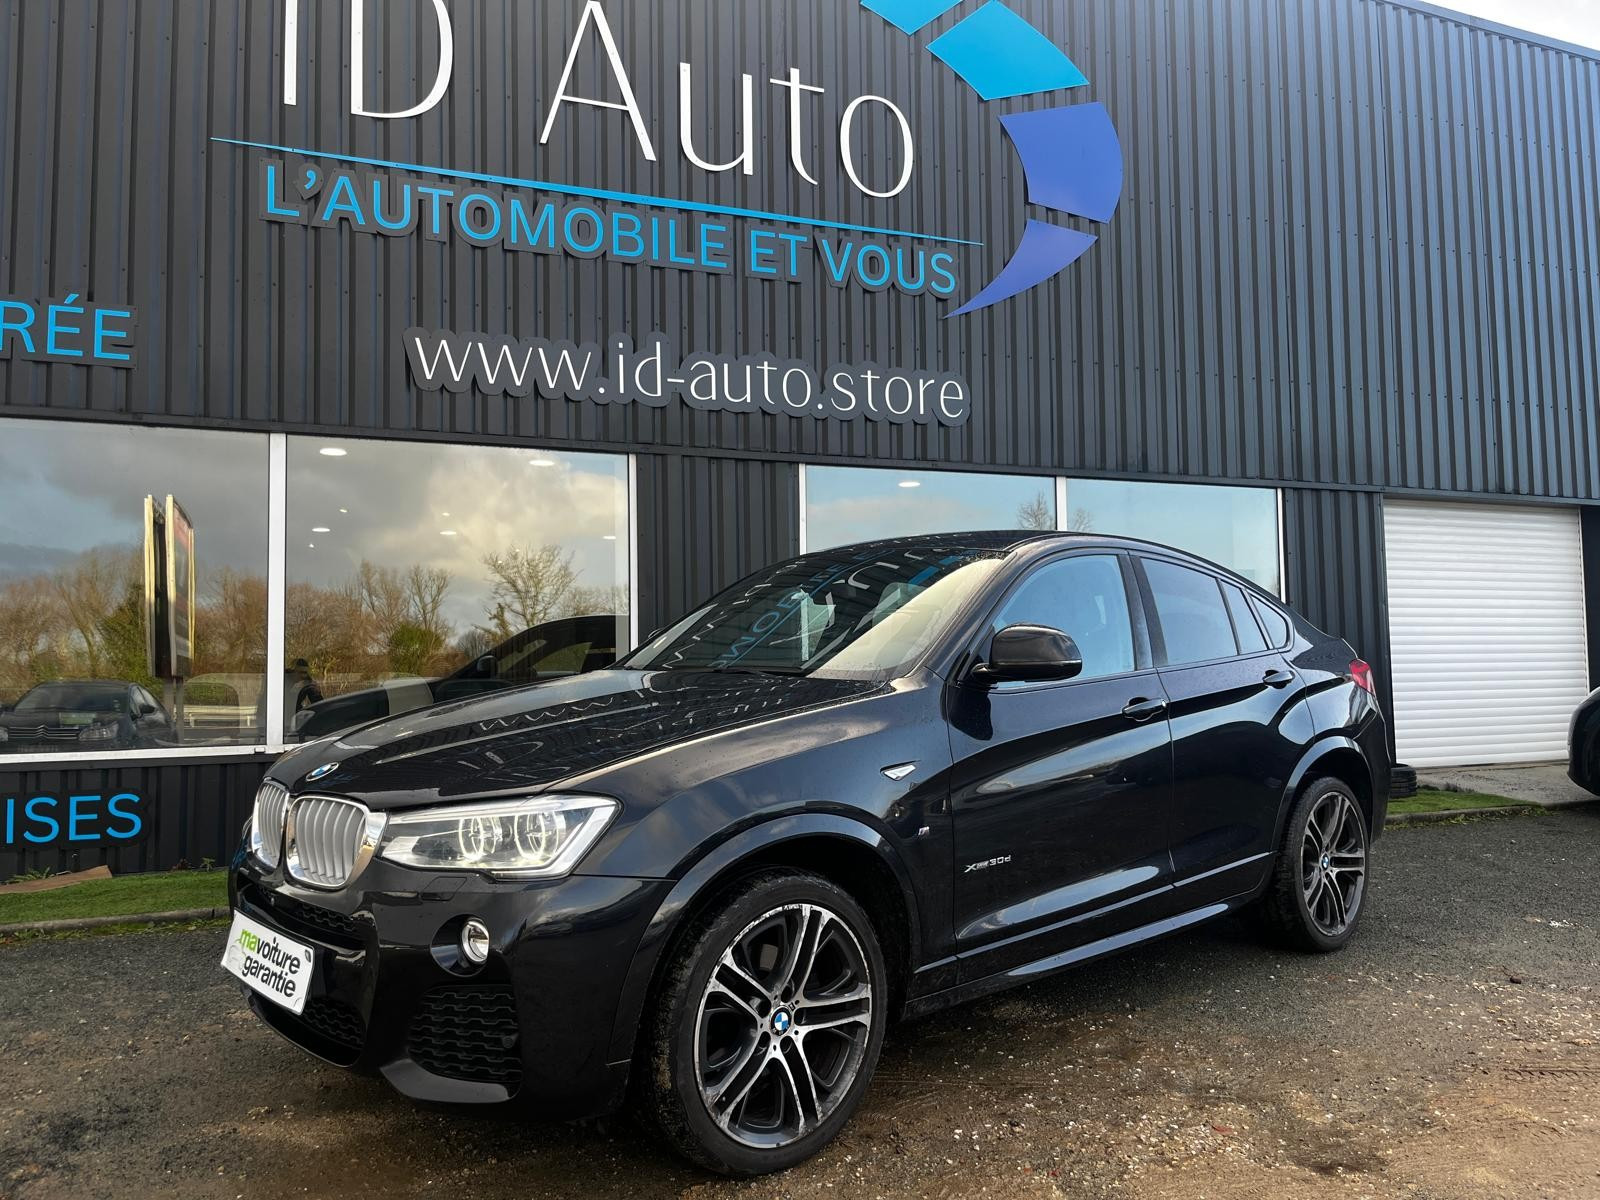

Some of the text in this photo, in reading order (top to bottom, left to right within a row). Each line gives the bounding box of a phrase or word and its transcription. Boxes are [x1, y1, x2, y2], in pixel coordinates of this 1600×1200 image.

[283, 0, 914, 197] ID Auto
[266, 165, 957, 293] L’AUTOMOBILE ET VOUS
[0, 293, 130, 360] RÉE
[414, 337, 964, 418] www.id-auto.store
[6, 793, 142, 844] ISES
[241, 955, 296, 998] garantie
